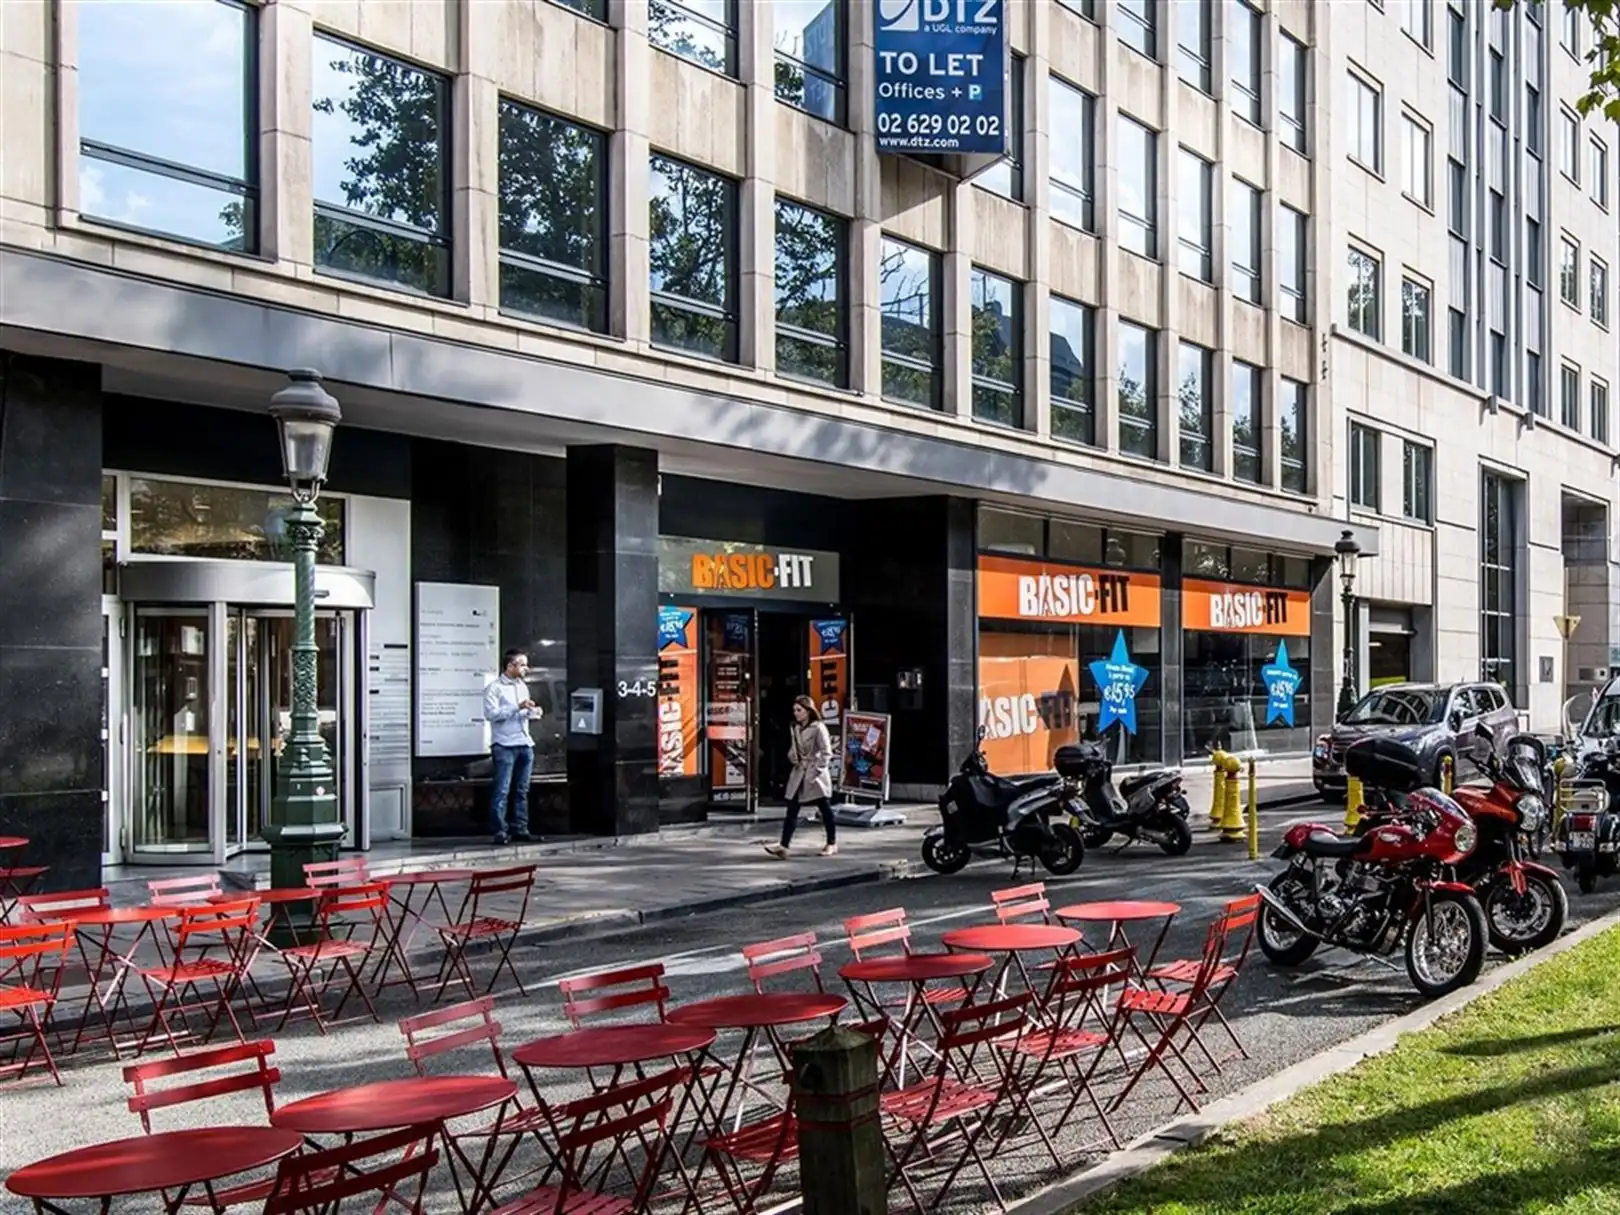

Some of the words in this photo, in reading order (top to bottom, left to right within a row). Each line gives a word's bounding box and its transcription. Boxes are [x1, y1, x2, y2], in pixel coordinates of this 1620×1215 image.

[923, 0, 998, 23] DTZ
[955, 25, 998, 35] company
[879, 51, 918, 75] TO
[929, 53, 984, 76] LET
[878, 82, 946, 100] Offices
[968, 84, 983, 100] P
[877, 112, 902, 133] 02
[907, 114, 942, 134] 629
[947, 115, 971, 135] 02
[975, 115, 1000, 136] 02
[879, 136, 960, 148] www.dtz.com
[617, 680, 656, 697] 3-4-5
